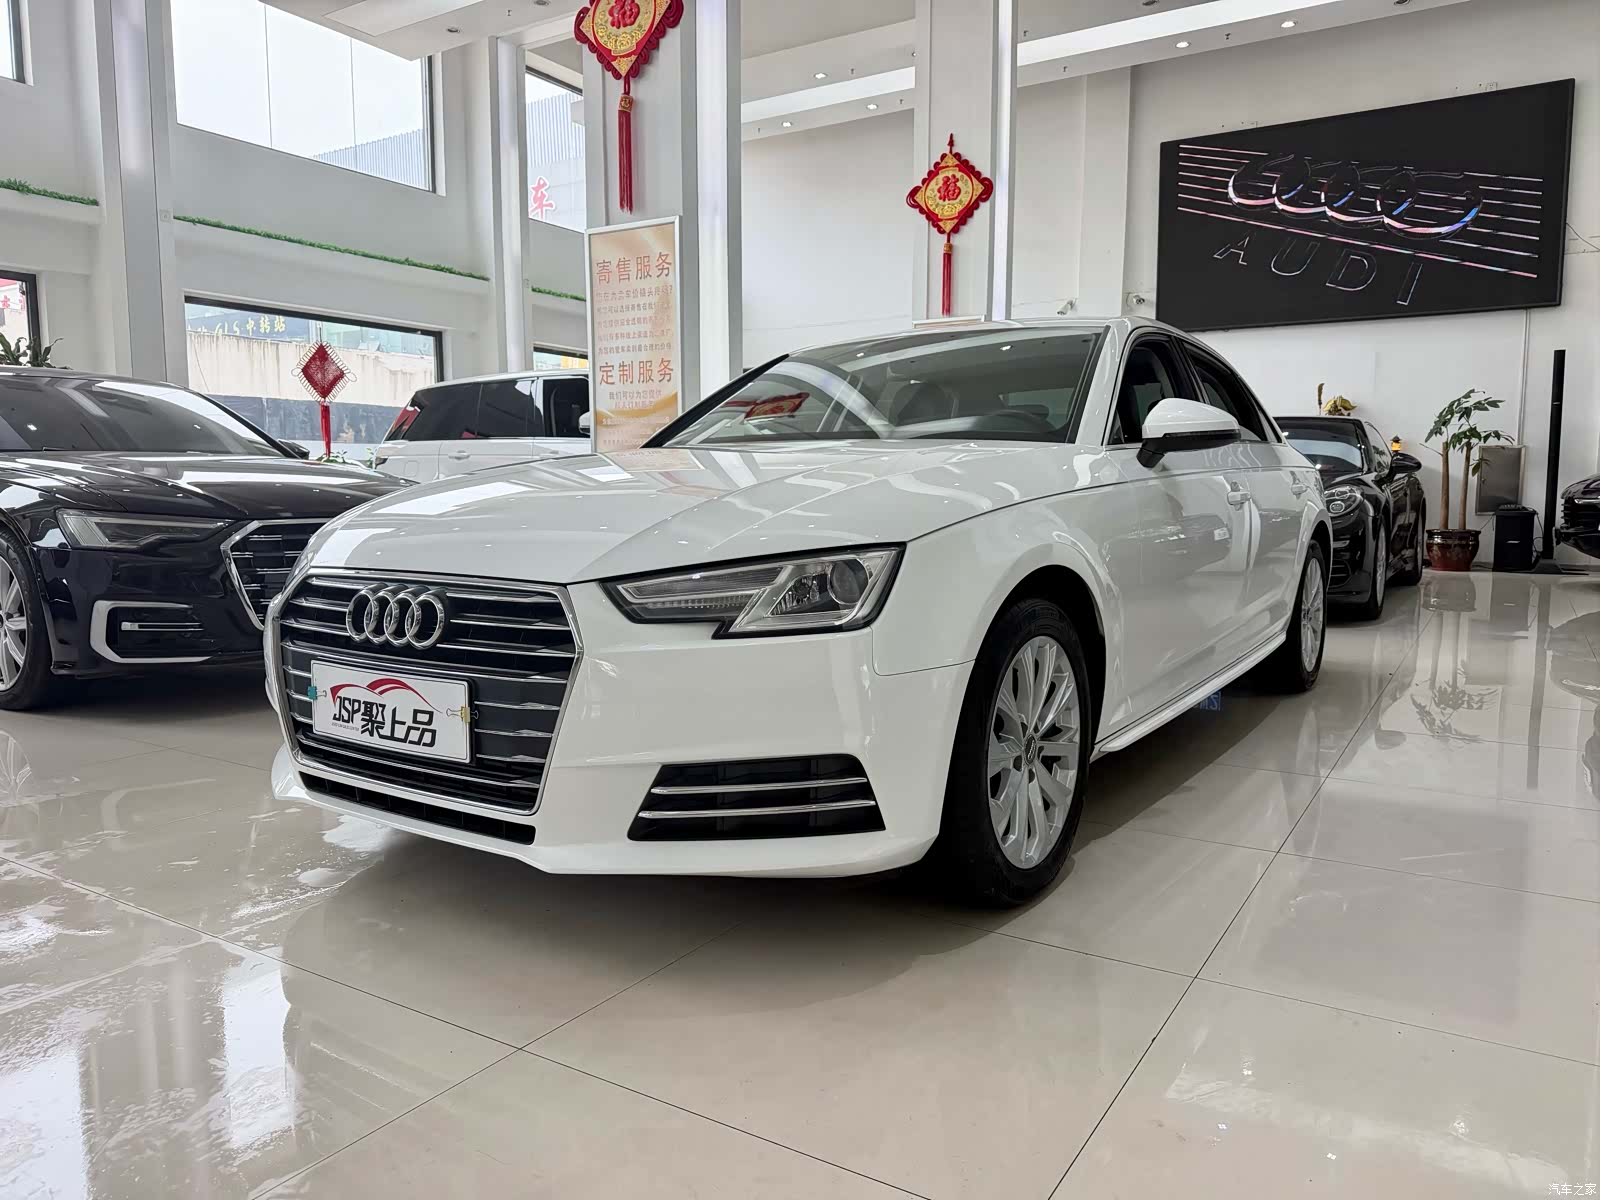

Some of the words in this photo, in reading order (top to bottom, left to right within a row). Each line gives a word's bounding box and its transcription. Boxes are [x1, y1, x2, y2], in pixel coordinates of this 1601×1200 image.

[937, 173, 961, 202] 福
[596, 251, 672, 284] 寄售服务
[1213, 231, 1423, 305] AUDI
[599, 357, 674, 385] 定制服务
